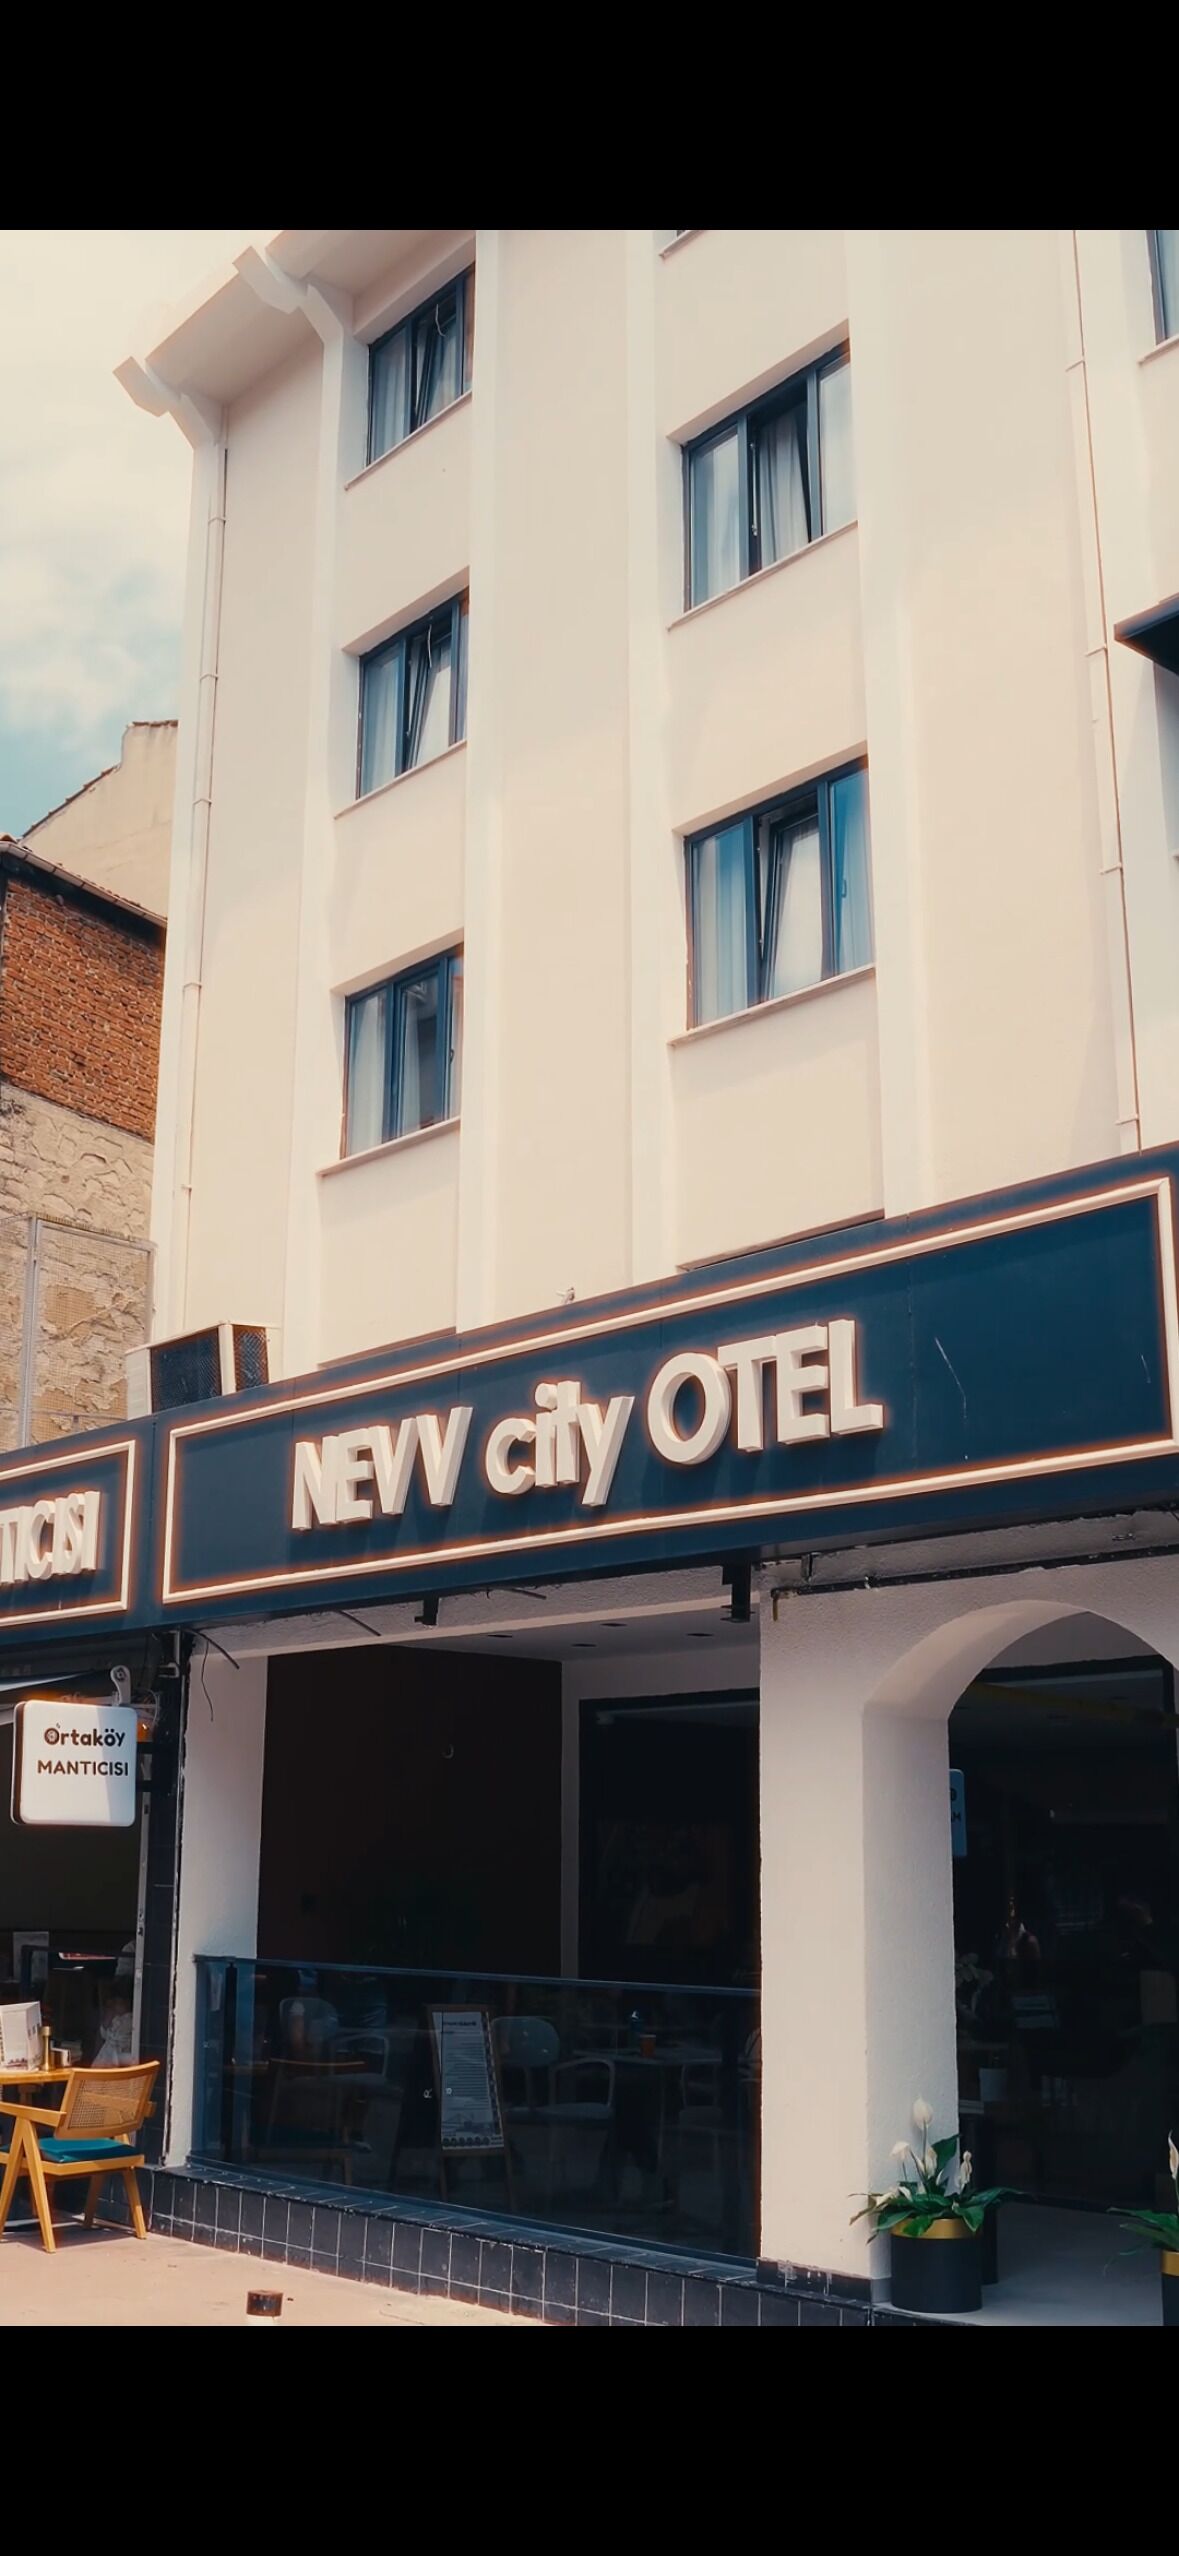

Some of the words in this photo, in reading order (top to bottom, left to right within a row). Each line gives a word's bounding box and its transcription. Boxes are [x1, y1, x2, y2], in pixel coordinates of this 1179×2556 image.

[486, 1380, 636, 1507] city
[647, 1319, 884, 1465] OTEL
[44, 1727, 126, 1747] Ortaköy
[37, 1759, 129, 1776] MANTICISI
